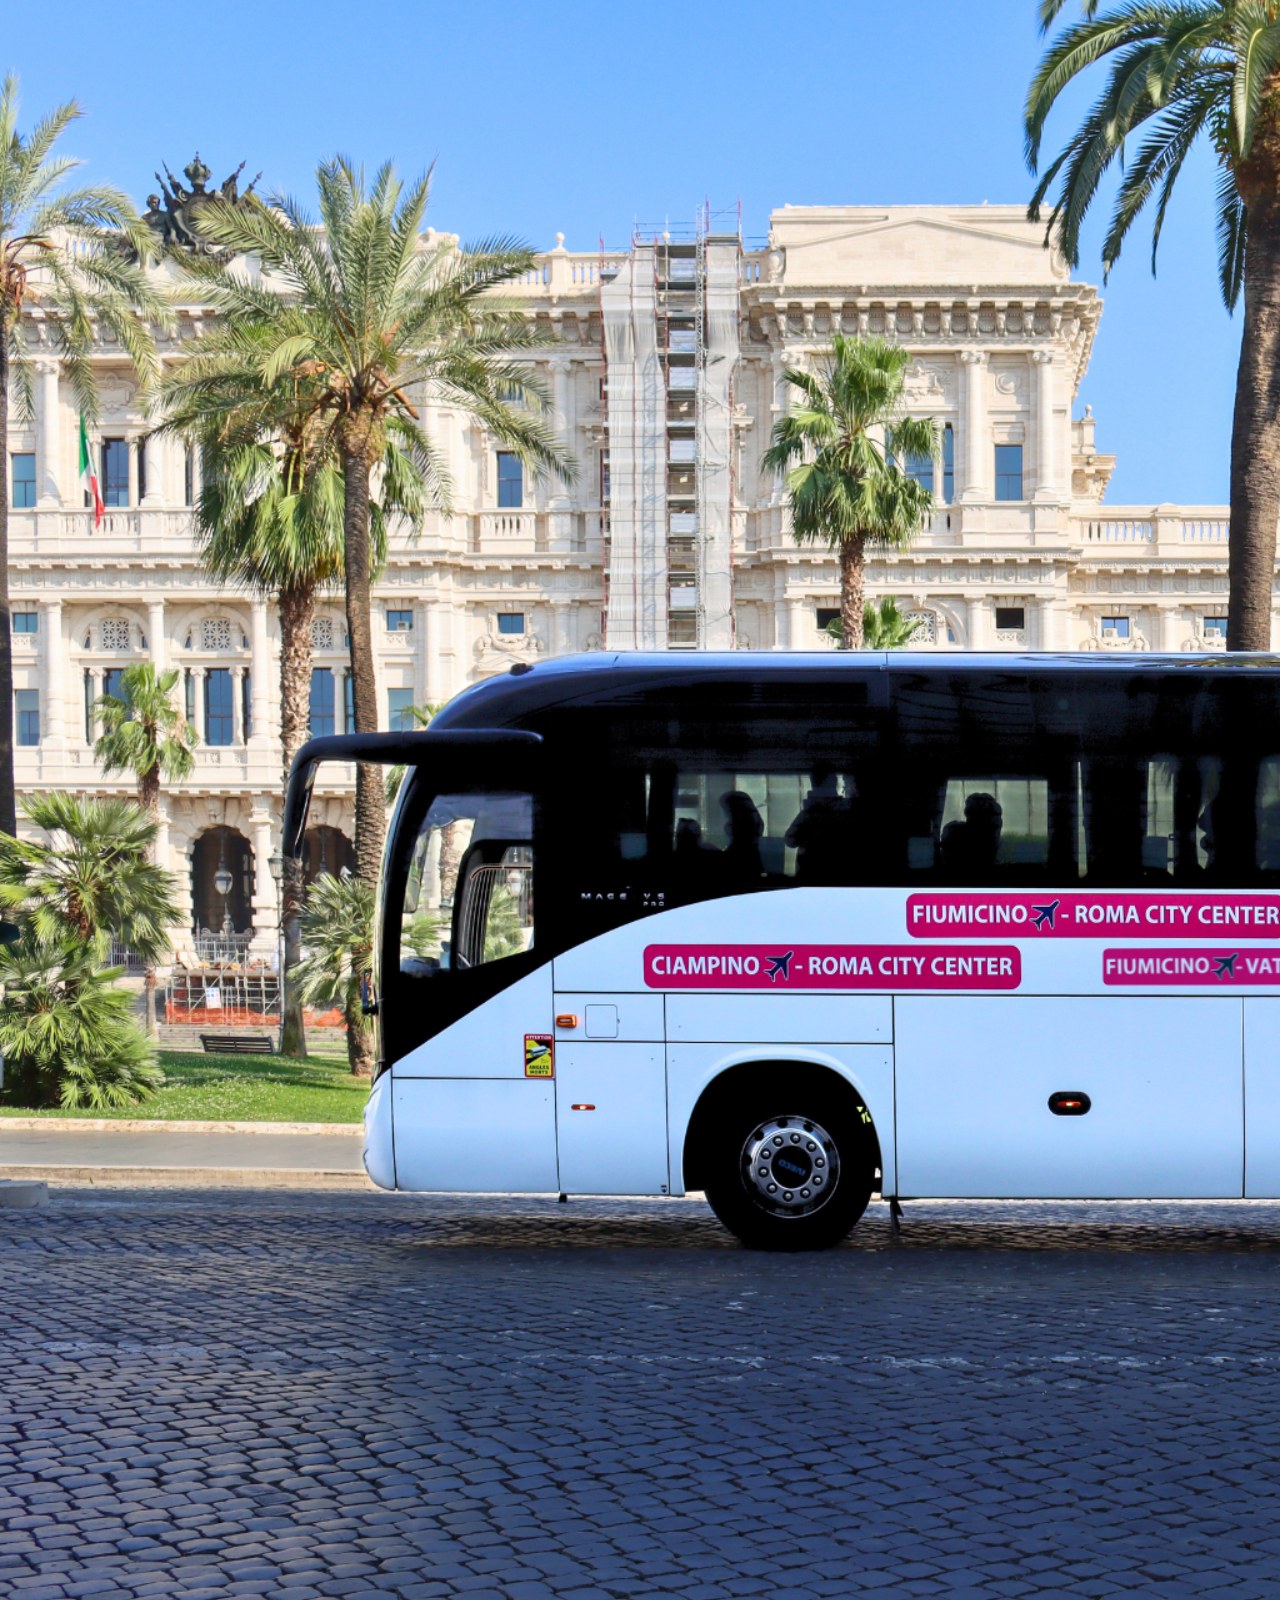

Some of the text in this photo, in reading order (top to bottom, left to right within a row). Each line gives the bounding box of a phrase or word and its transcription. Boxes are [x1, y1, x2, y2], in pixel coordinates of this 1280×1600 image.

[913, 904, 1028, 924] FIUMICINO
[1075, 904, 1140, 924] ROMA
[1145, 905, 1193, 924] CITY
[1197, 905, 1280, 925] CENTER
[651, 956, 760, 976] CIAMPINO
[808, 956, 874, 976] ROMA
[878, 956, 926, 976] CITY
[930, 956, 1013, 976] CENTER
[1106, 957, 1210, 975] FIUMICINO
